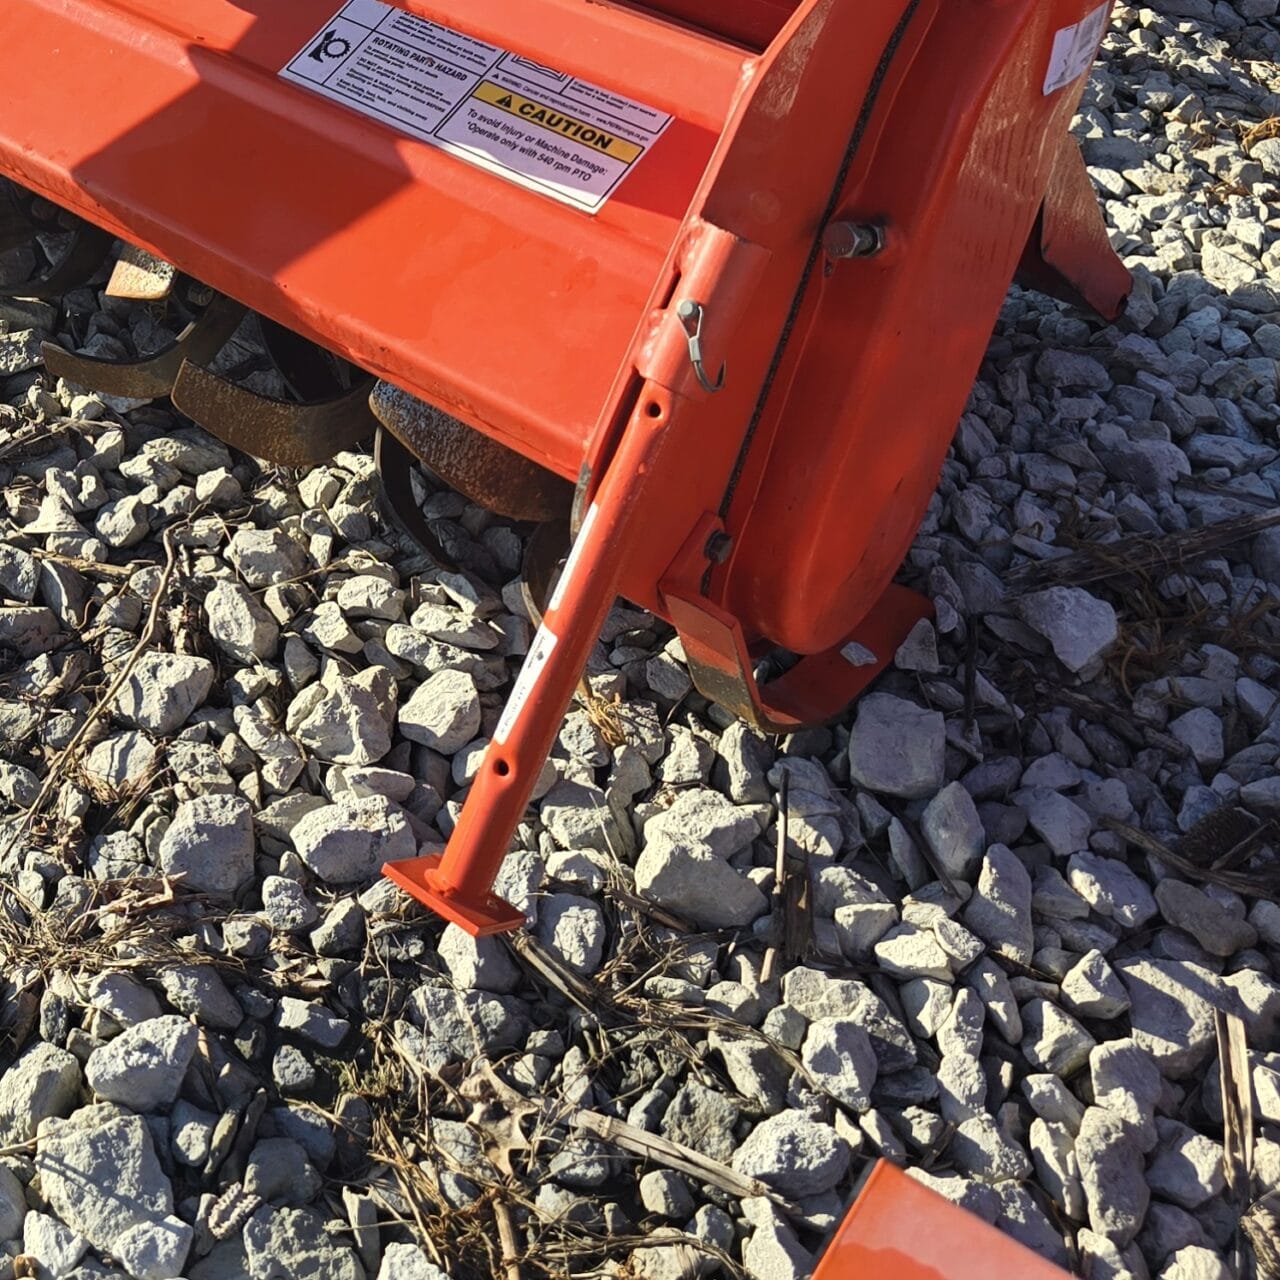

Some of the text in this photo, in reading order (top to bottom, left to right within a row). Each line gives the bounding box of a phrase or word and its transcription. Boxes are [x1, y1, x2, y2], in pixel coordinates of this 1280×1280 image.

[372, 37, 467, 81] ROTATING PARTS HAZARD
[467, 108, 607, 175] To avoid Injury or Machine Damage:
[519, 103, 612, 148] CAUTION
[500, 138, 519, 151] only
[519, 146, 537, 158] with
[537, 153, 554, 165] 540
[553, 161, 571, 173] rpm
[571, 168, 591, 181] PTO
